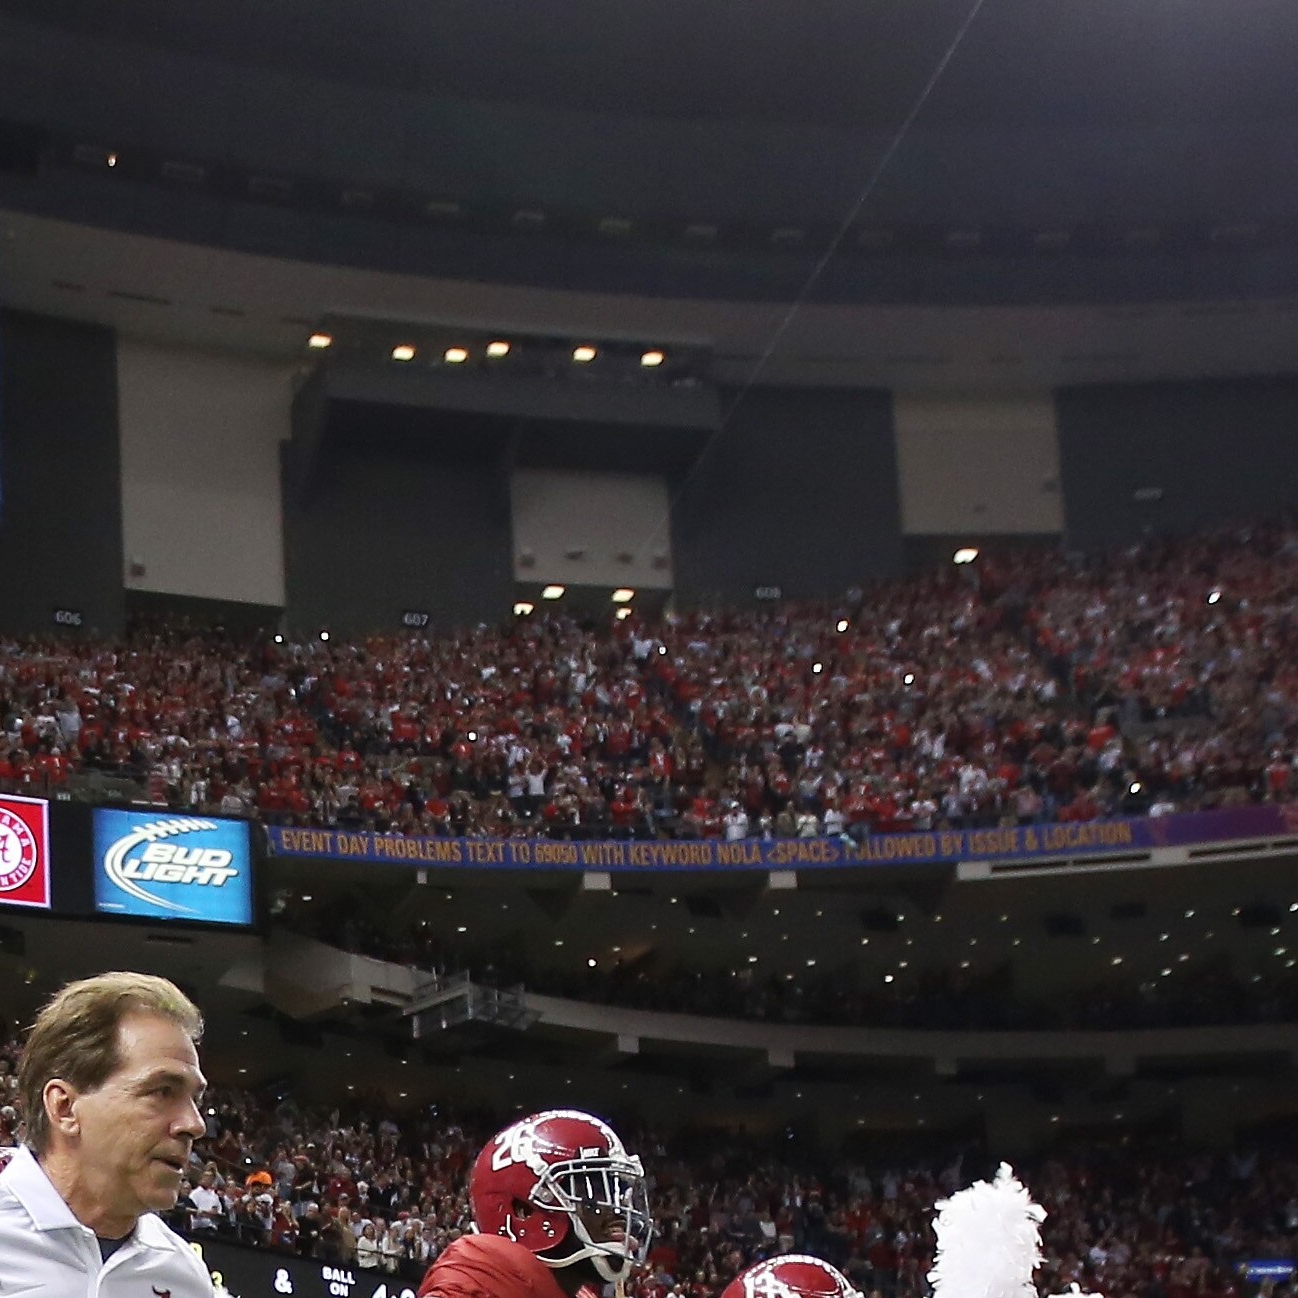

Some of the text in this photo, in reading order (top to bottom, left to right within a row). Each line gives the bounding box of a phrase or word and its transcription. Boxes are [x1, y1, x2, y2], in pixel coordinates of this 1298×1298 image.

[143, 842, 233, 868] BUD
[281, 829, 332, 852] EVENT
[337, 834, 369, 855] DAY
[374, 837, 462, 862] PROBLEMS
[466, 841, 504, 863] TEXT
[511, 842, 530, 863] TO
[535, 842, 577, 864] 69050
[582, 843, 624, 864] WITH
[630, 843, 712, 864] KEYWORD
[717, 843, 763, 864] NOLA
[941, 833, 963, 856] BY
[969, 828, 1019, 854] ISSUE
[1025, 827, 1038, 851] &
[1043, 821, 1133, 851] LOCATION
[11, 857, 33, 883] TIDE
[123, 859, 239, 887] LIGHT
[492, 1123, 536, 1172] 26
[273, 1268, 293, 1295] &
[322, 1265, 356, 1285] BALL
[329, 1282, 349, 1298] ON
